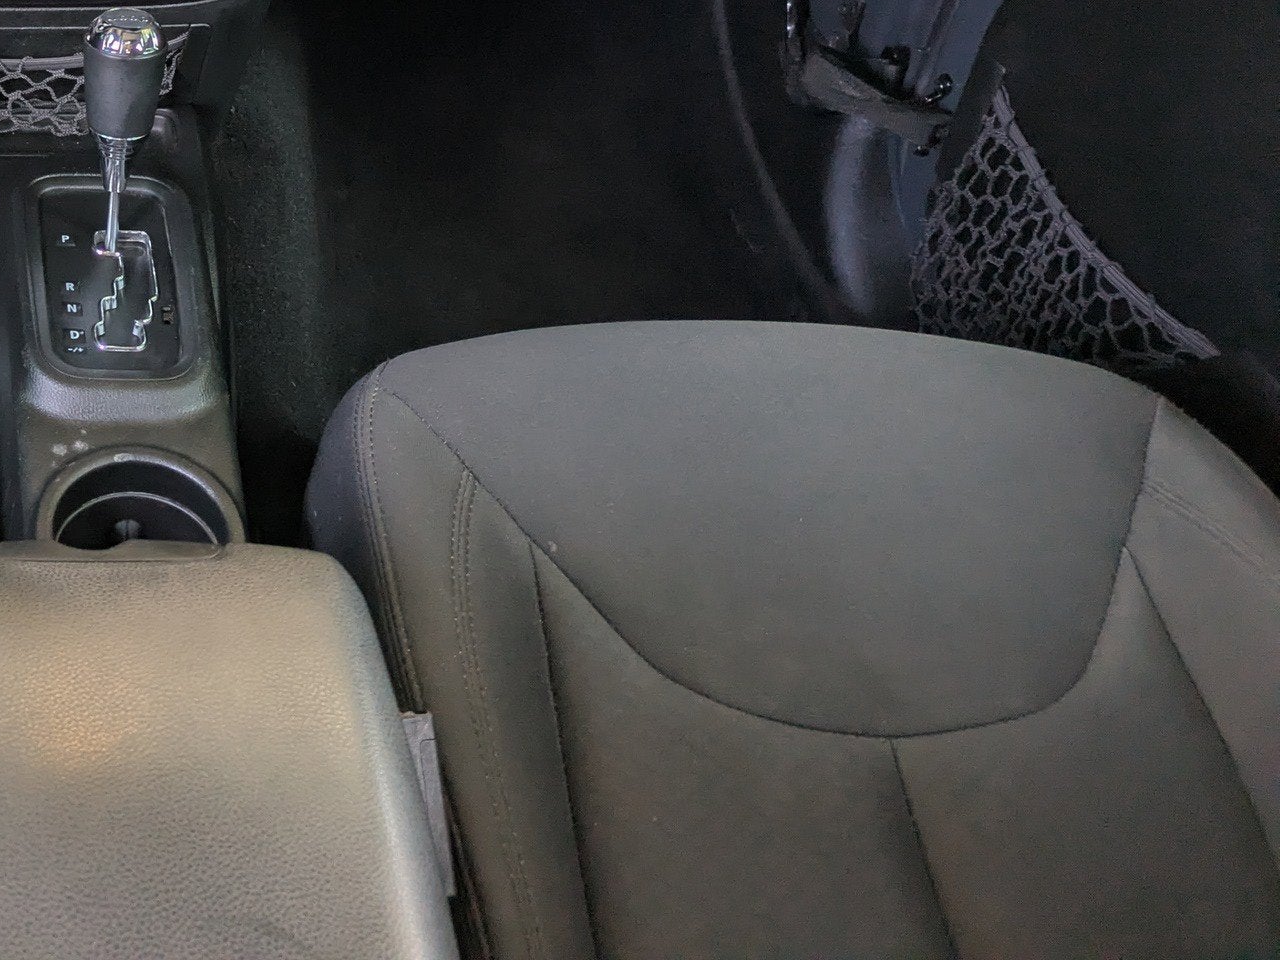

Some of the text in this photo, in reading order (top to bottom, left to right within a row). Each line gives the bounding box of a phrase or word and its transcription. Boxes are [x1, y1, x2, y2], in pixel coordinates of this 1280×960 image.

[61, 235, 70, 243] P
[65, 282, 75, 291] R
[67, 304, 76, 313] N
[70, 330, 80, 339] D
